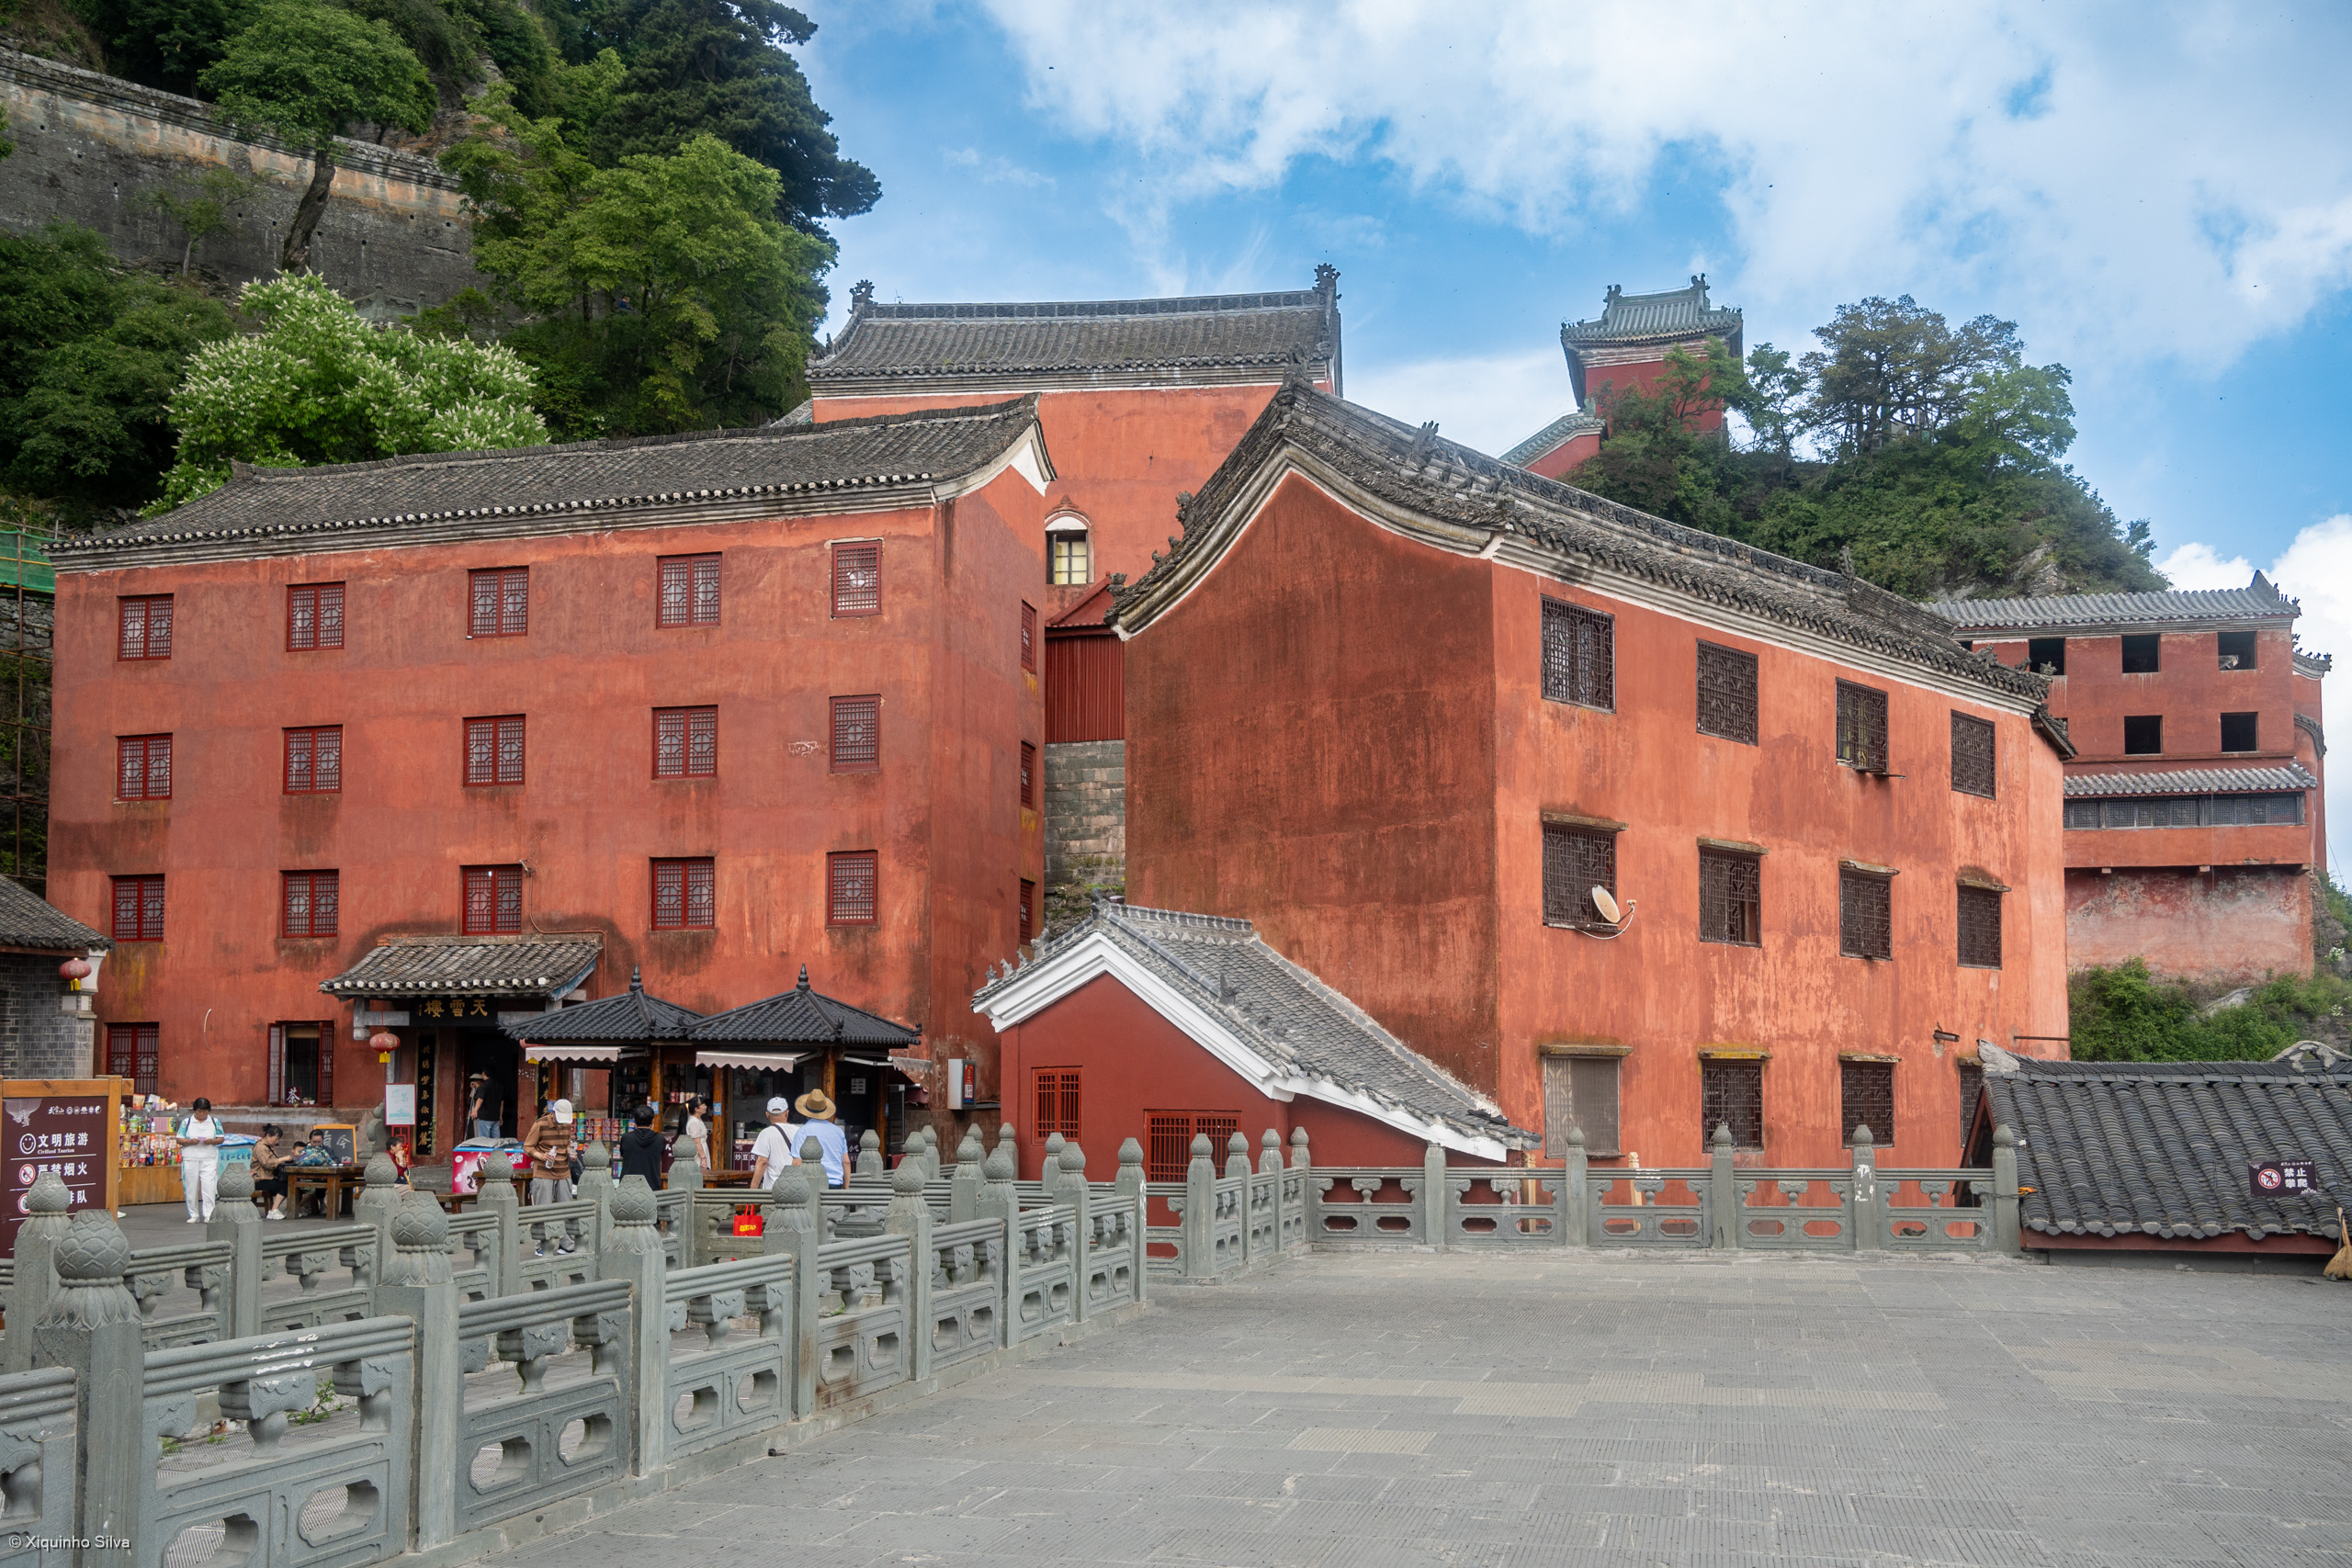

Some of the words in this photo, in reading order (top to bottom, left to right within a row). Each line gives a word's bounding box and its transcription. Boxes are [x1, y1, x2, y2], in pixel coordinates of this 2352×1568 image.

[38, 1132, 89, 1148] 文明旅游
[2284, 1168, 2307, 1178] 禁止
